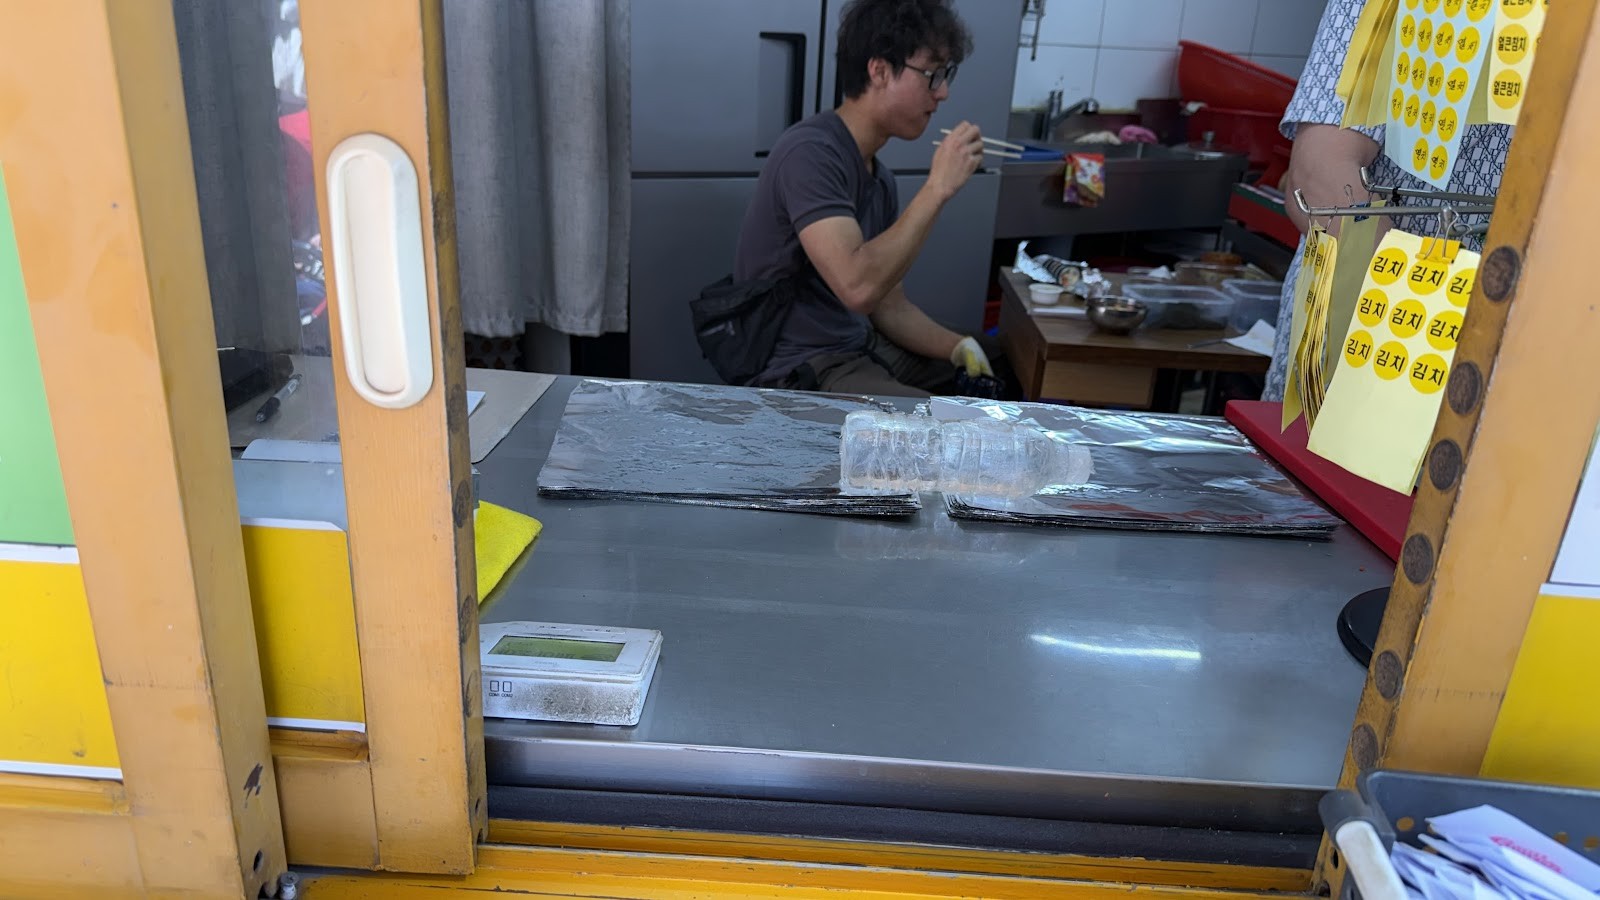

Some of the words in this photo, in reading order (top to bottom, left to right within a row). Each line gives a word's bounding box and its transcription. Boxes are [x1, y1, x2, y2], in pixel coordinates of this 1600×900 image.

[1497, 36, 1527, 53] 얼큰참치
[1493, 80, 1521, 98] 얼큰참치
[1373, 256, 1404, 277] 김치
[1410, 265, 1445, 287] 김치
[1449, 277, 1471, 295] 김
[1359, 297, 1387, 319] 김치
[1391, 308, 1424, 330] 김치
[1346, 338, 1371, 360] 김치
[1376, 349, 1406, 373] 김치
[1412, 361, 1446, 387] 김치
